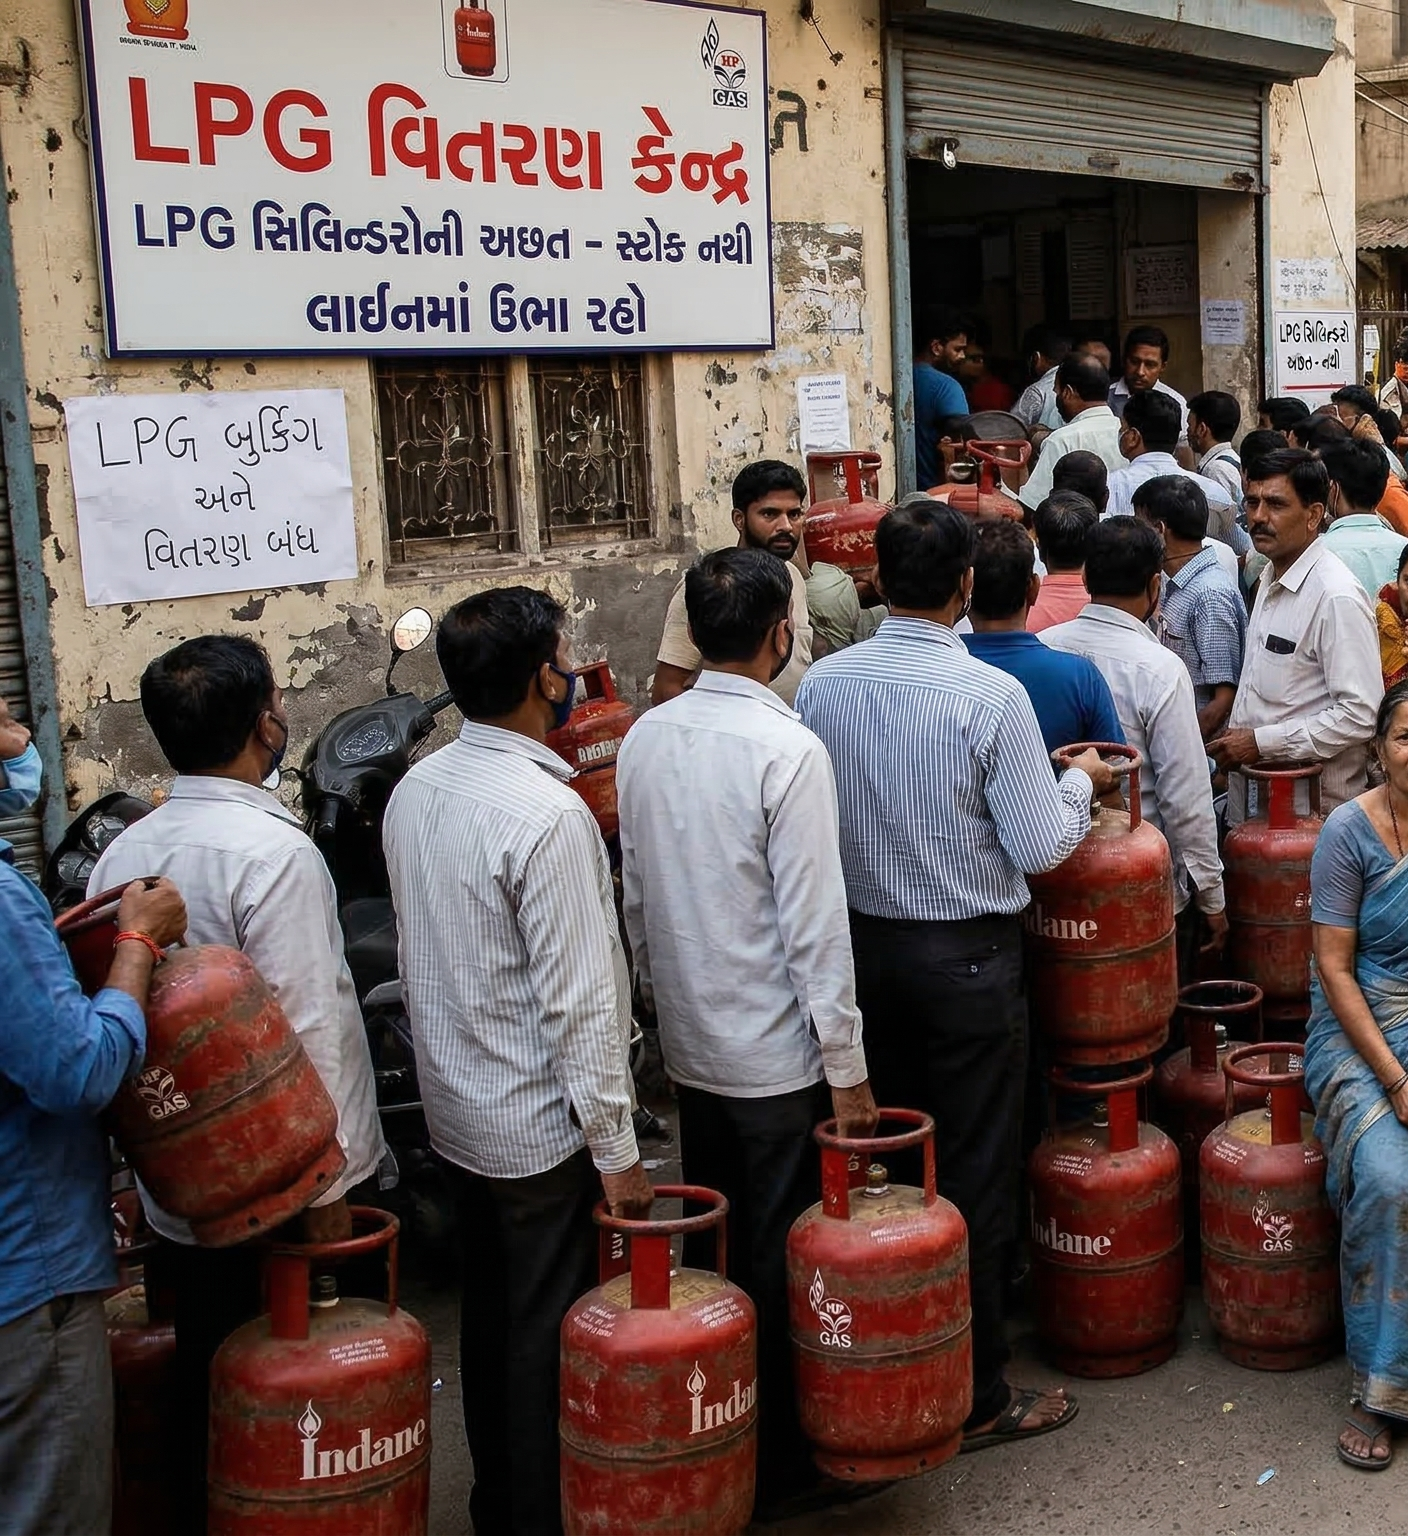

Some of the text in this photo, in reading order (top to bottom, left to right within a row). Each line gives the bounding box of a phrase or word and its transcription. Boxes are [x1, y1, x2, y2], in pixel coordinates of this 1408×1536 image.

[721, 55, 740, 67] HP
[714, 89, 747, 108] GAS
[128, 76, 333, 172] LPG
[367, 82, 603, 190] વિતરણ
[631, 106, 750, 205] કેન્દ્ર
[134, 203, 236, 249] LPG
[252, 199, 463, 256] સિલિન્ડરોની
[480, 223, 570, 260] અછત
[616, 217, 686, 263] સ્ટોક
[698, 221, 753, 265] નથી
[306, 280, 647, 334] લાઈનમાં ઉભા રહો
[1280, 323, 1301, 342] LPG
[96, 415, 198, 467] LPG
[194, 471, 256, 513] અને
[144, 528, 251, 571] વિતરણ
[150, 1094, 188, 1118] GAS
[1263, 1239, 1293, 1251] GAS
[820, 1331, 852, 1348] GAS
[299, 1418, 426, 1480] Indane
